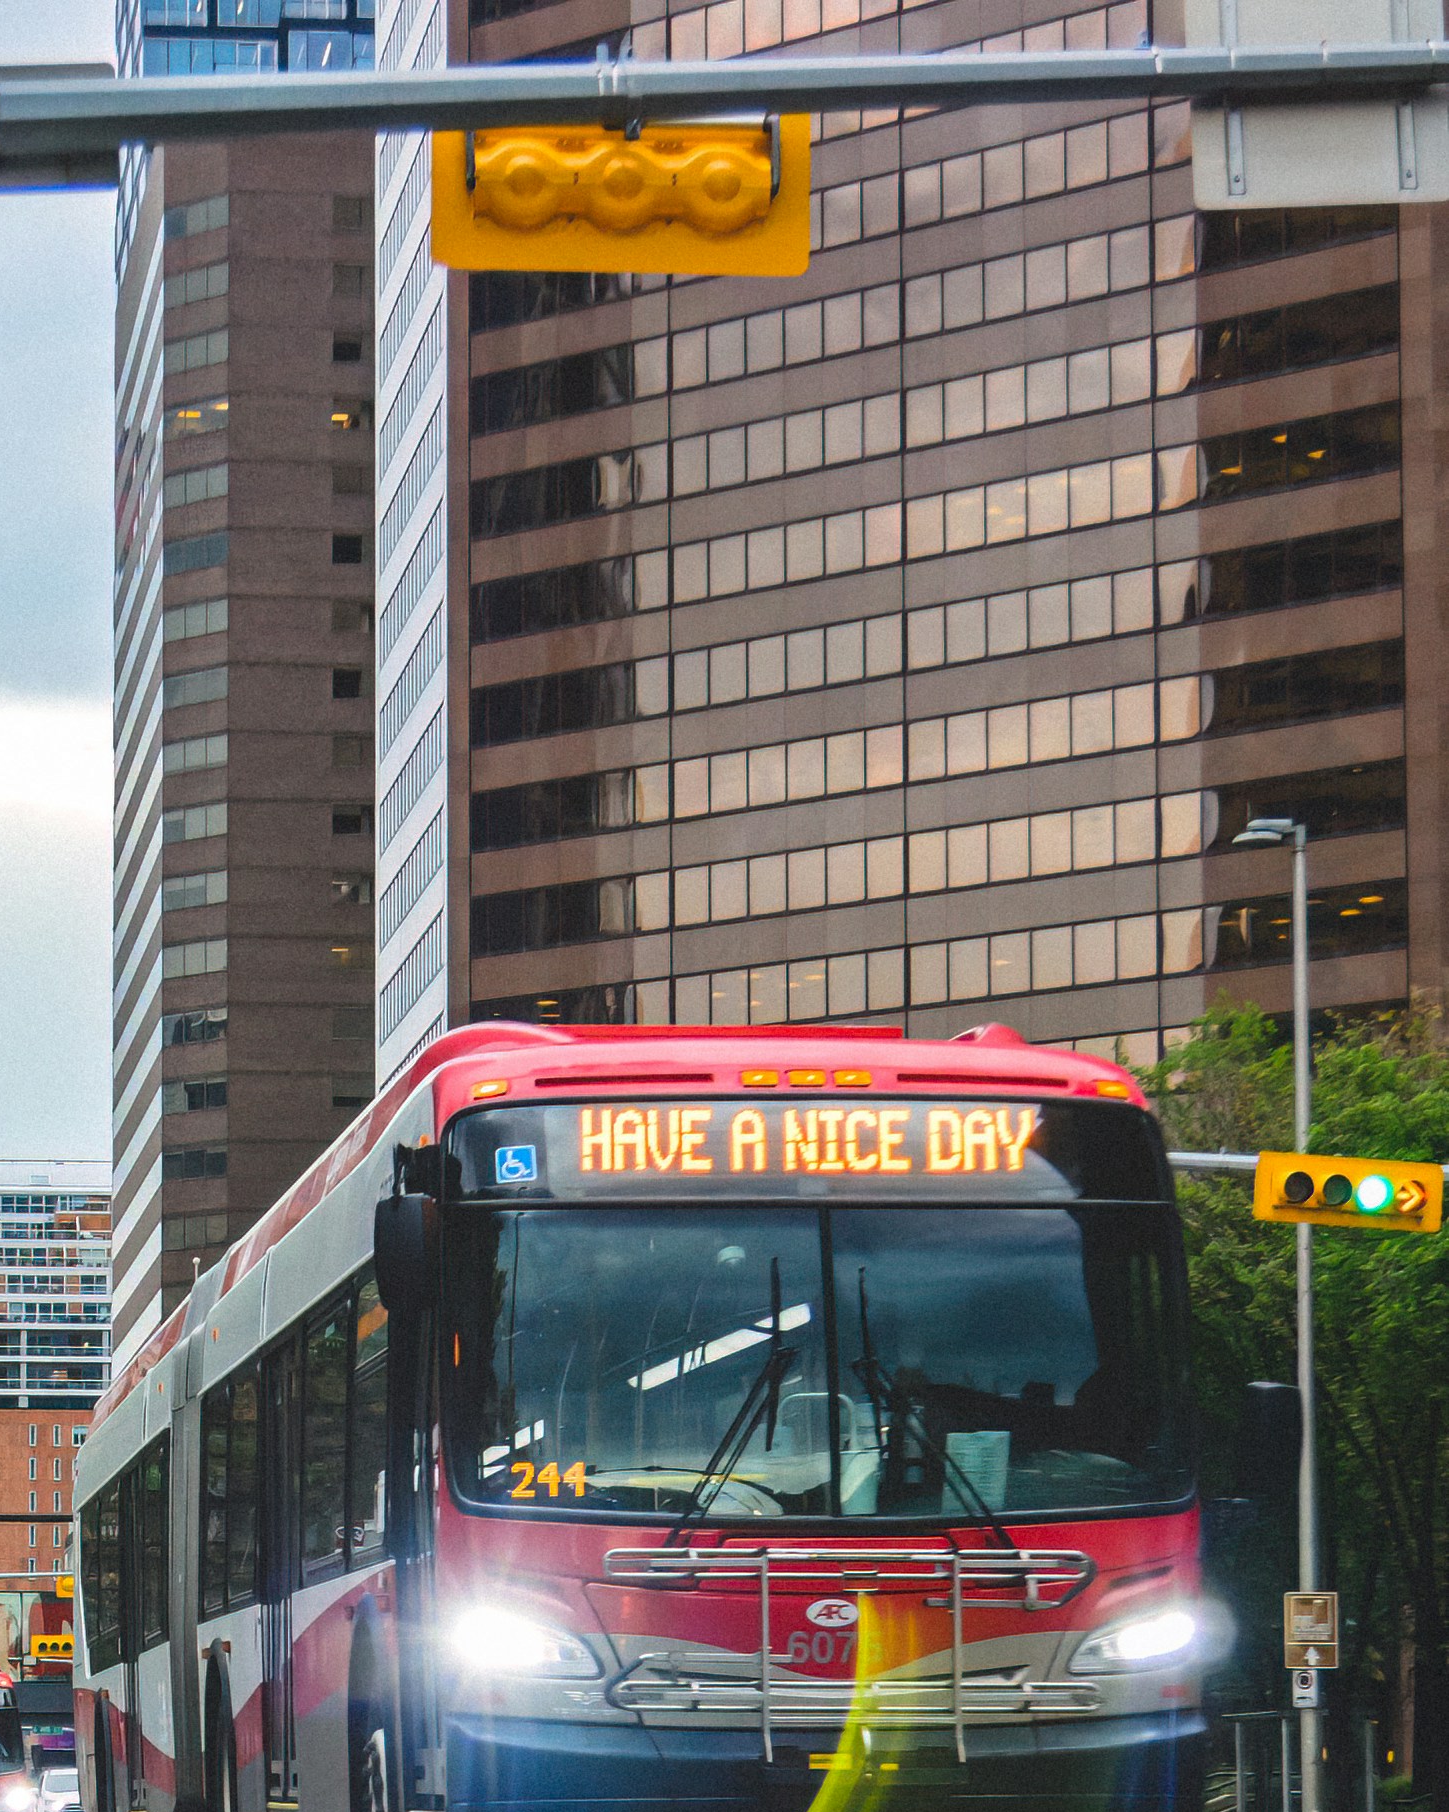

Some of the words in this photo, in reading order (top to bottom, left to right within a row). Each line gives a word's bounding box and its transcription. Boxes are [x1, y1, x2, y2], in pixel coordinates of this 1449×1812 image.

[581, 1107, 713, 1172] HAVE
[730, 1107, 767, 1171] A
[784, 1108, 911, 1172] NICE
[926, 1108, 1037, 1172] DAY
[511, 1461, 586, 1498] 244
